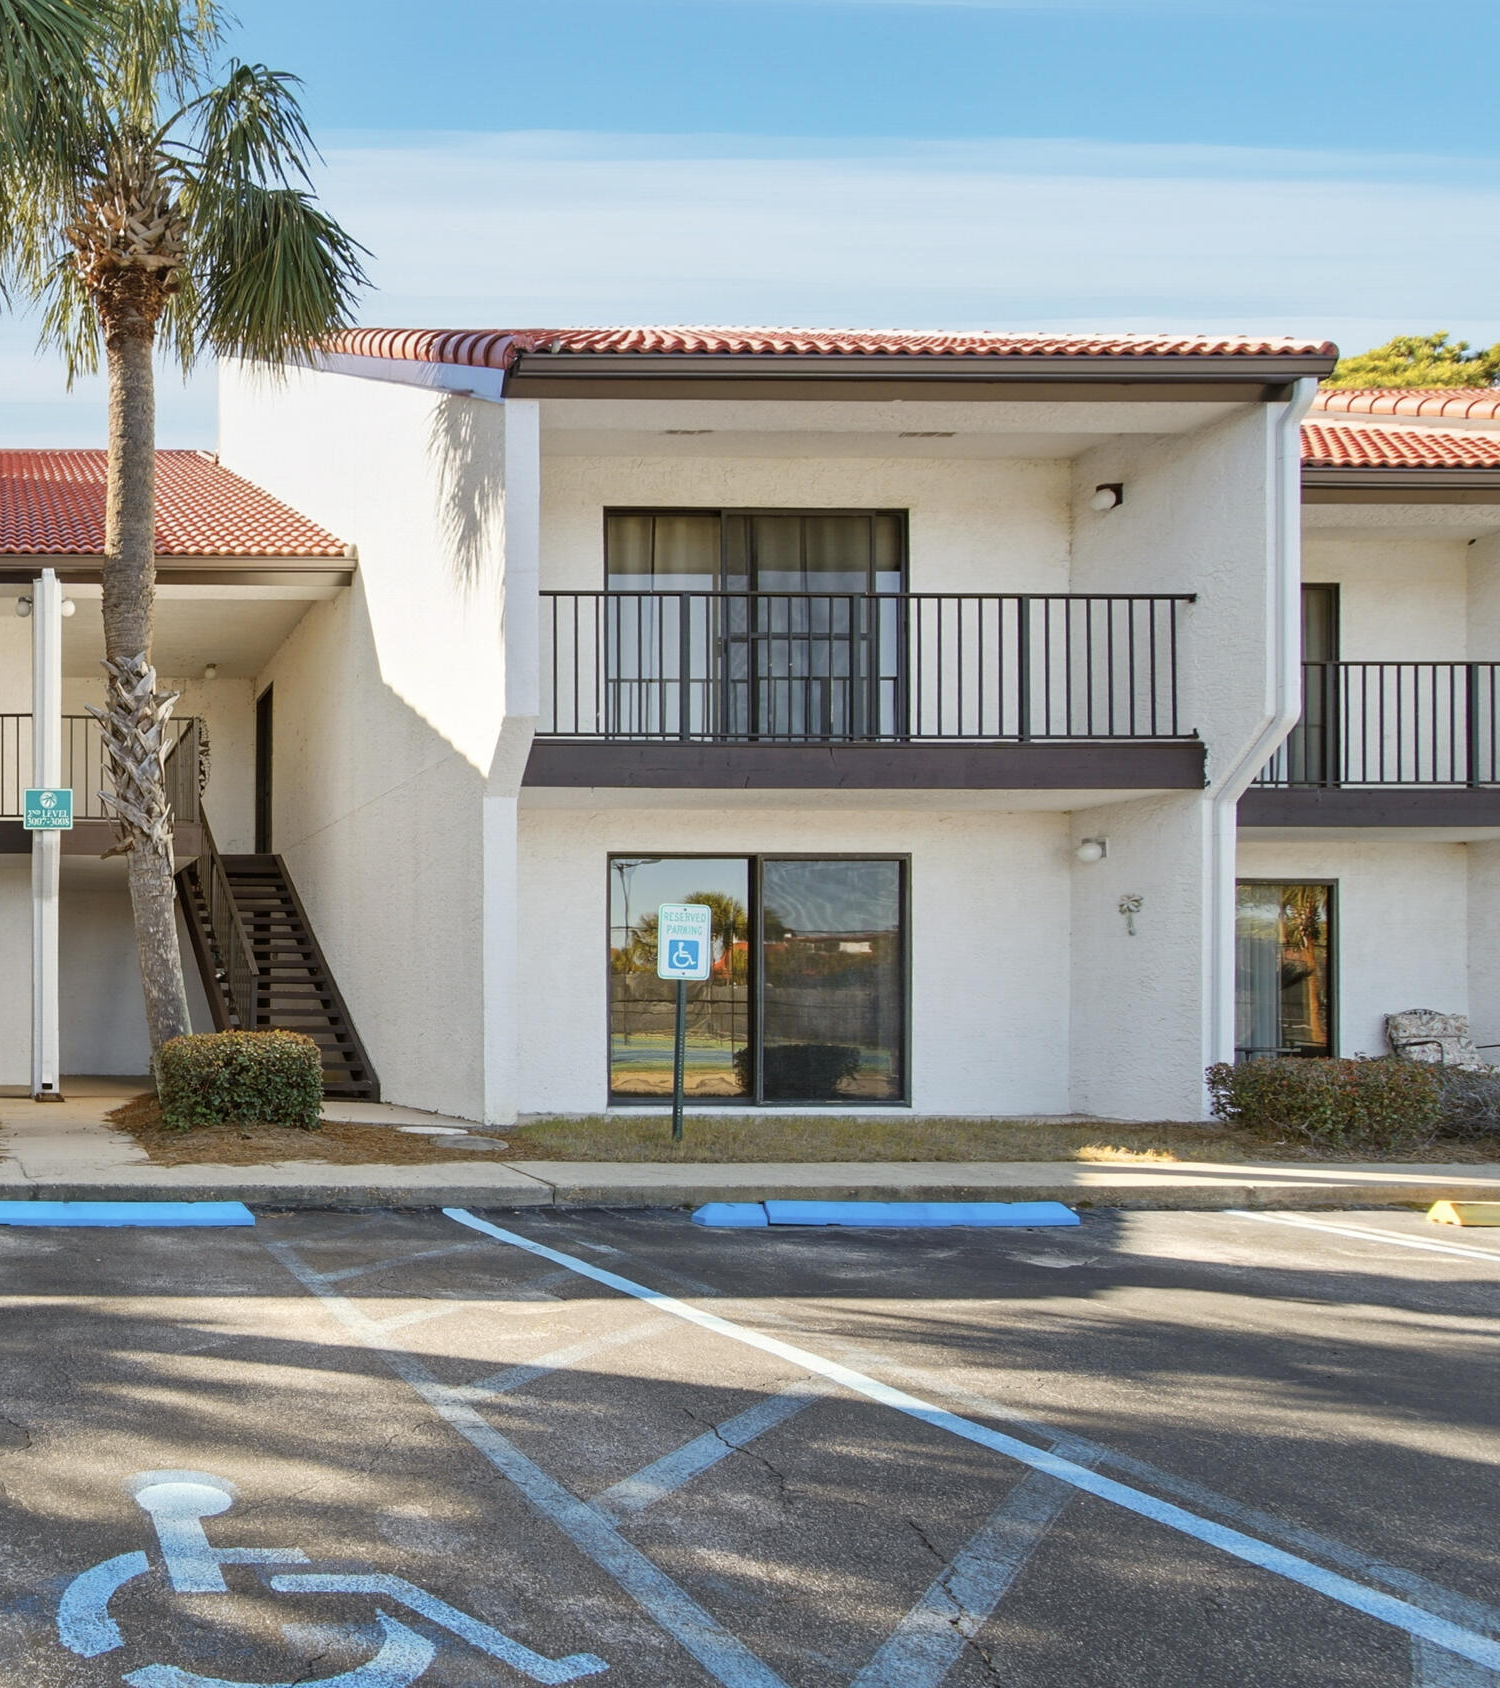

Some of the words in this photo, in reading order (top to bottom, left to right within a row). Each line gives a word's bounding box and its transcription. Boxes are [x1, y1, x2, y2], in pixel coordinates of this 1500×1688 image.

[42, 810, 69, 818] LEVEL
[663, 912, 707, 923] RESERVED
[666, 925, 702, 936] PARKING
